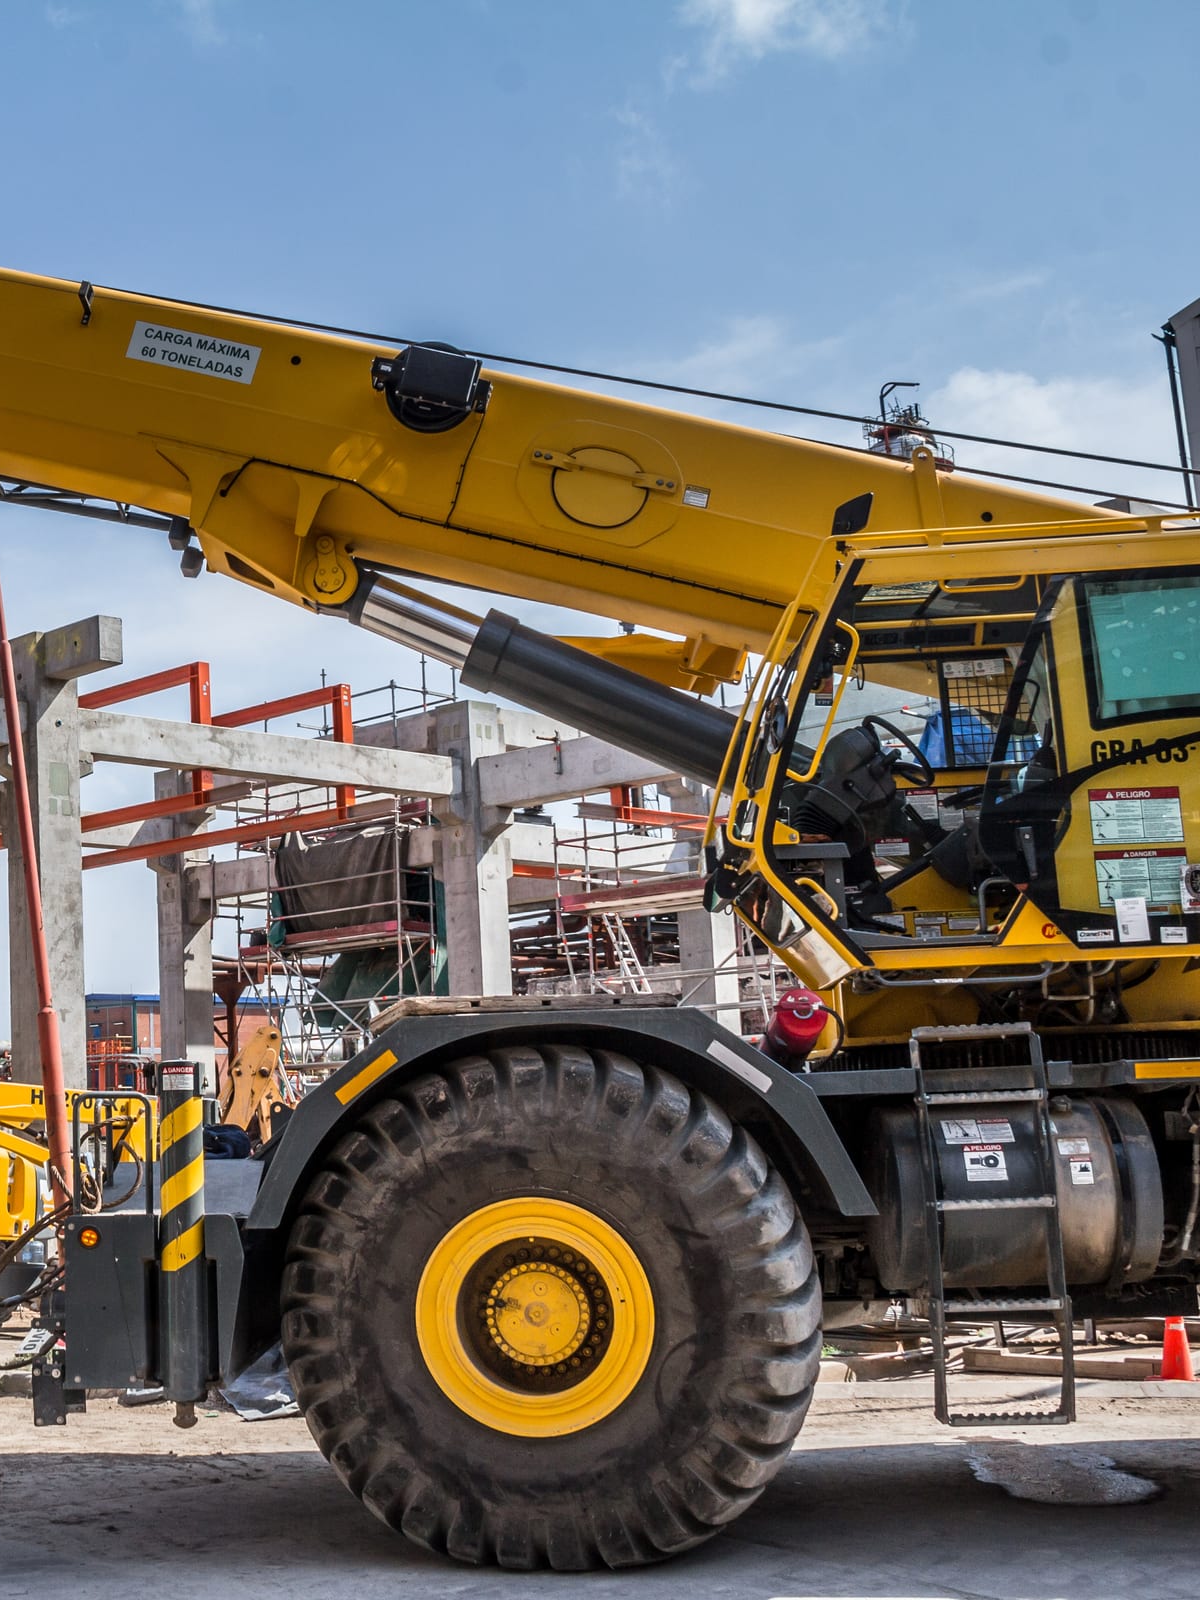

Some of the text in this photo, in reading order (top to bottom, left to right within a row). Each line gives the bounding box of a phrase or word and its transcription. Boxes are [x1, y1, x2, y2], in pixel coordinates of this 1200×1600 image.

[144, 327, 251, 360] CARGA MÁXIMA
[141, 346, 243, 378] 60 TONELADAS
[1115, 790, 1151, 799] PELIGRO
[1129, 850, 1158, 858] DANGER
